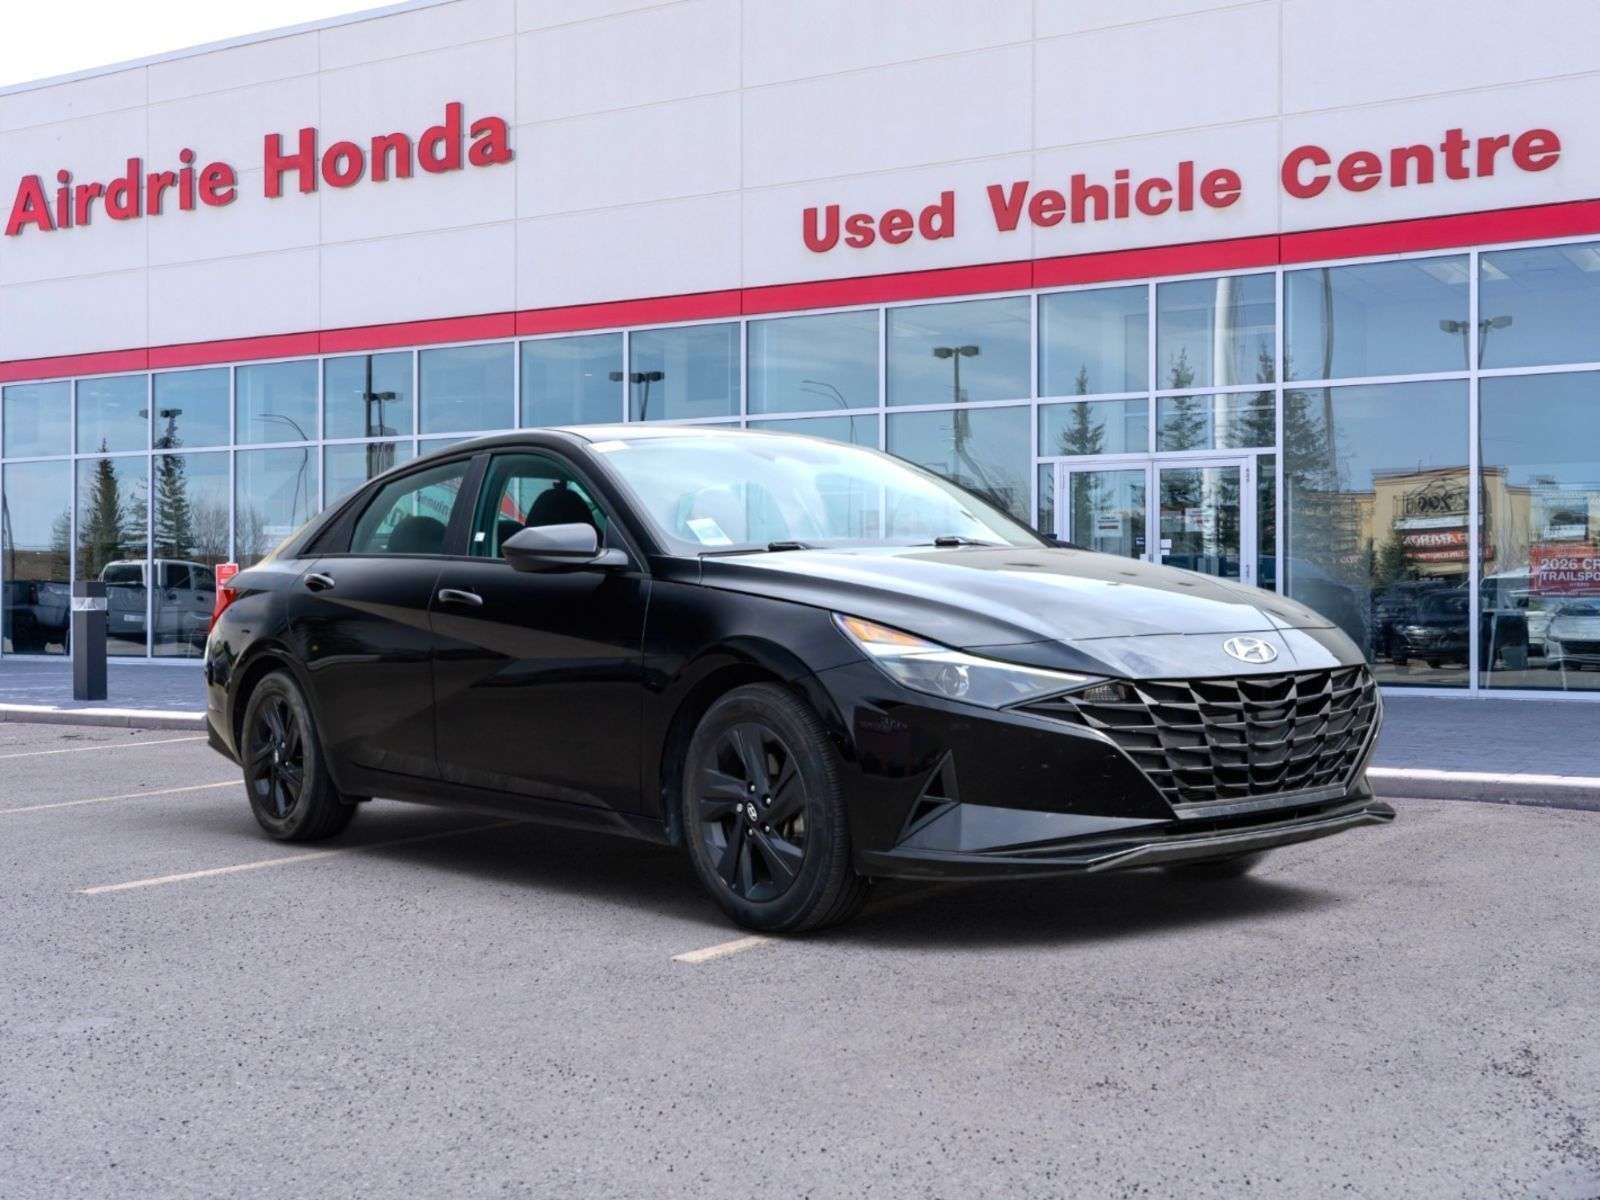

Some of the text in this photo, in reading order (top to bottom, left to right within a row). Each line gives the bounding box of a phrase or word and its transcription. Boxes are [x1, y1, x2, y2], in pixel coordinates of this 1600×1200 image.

[6, 102, 513, 235] Airdrie Honda
[802, 128, 1562, 253] Used Vehicle Centre
[1540, 558, 1578, 570] 2026
